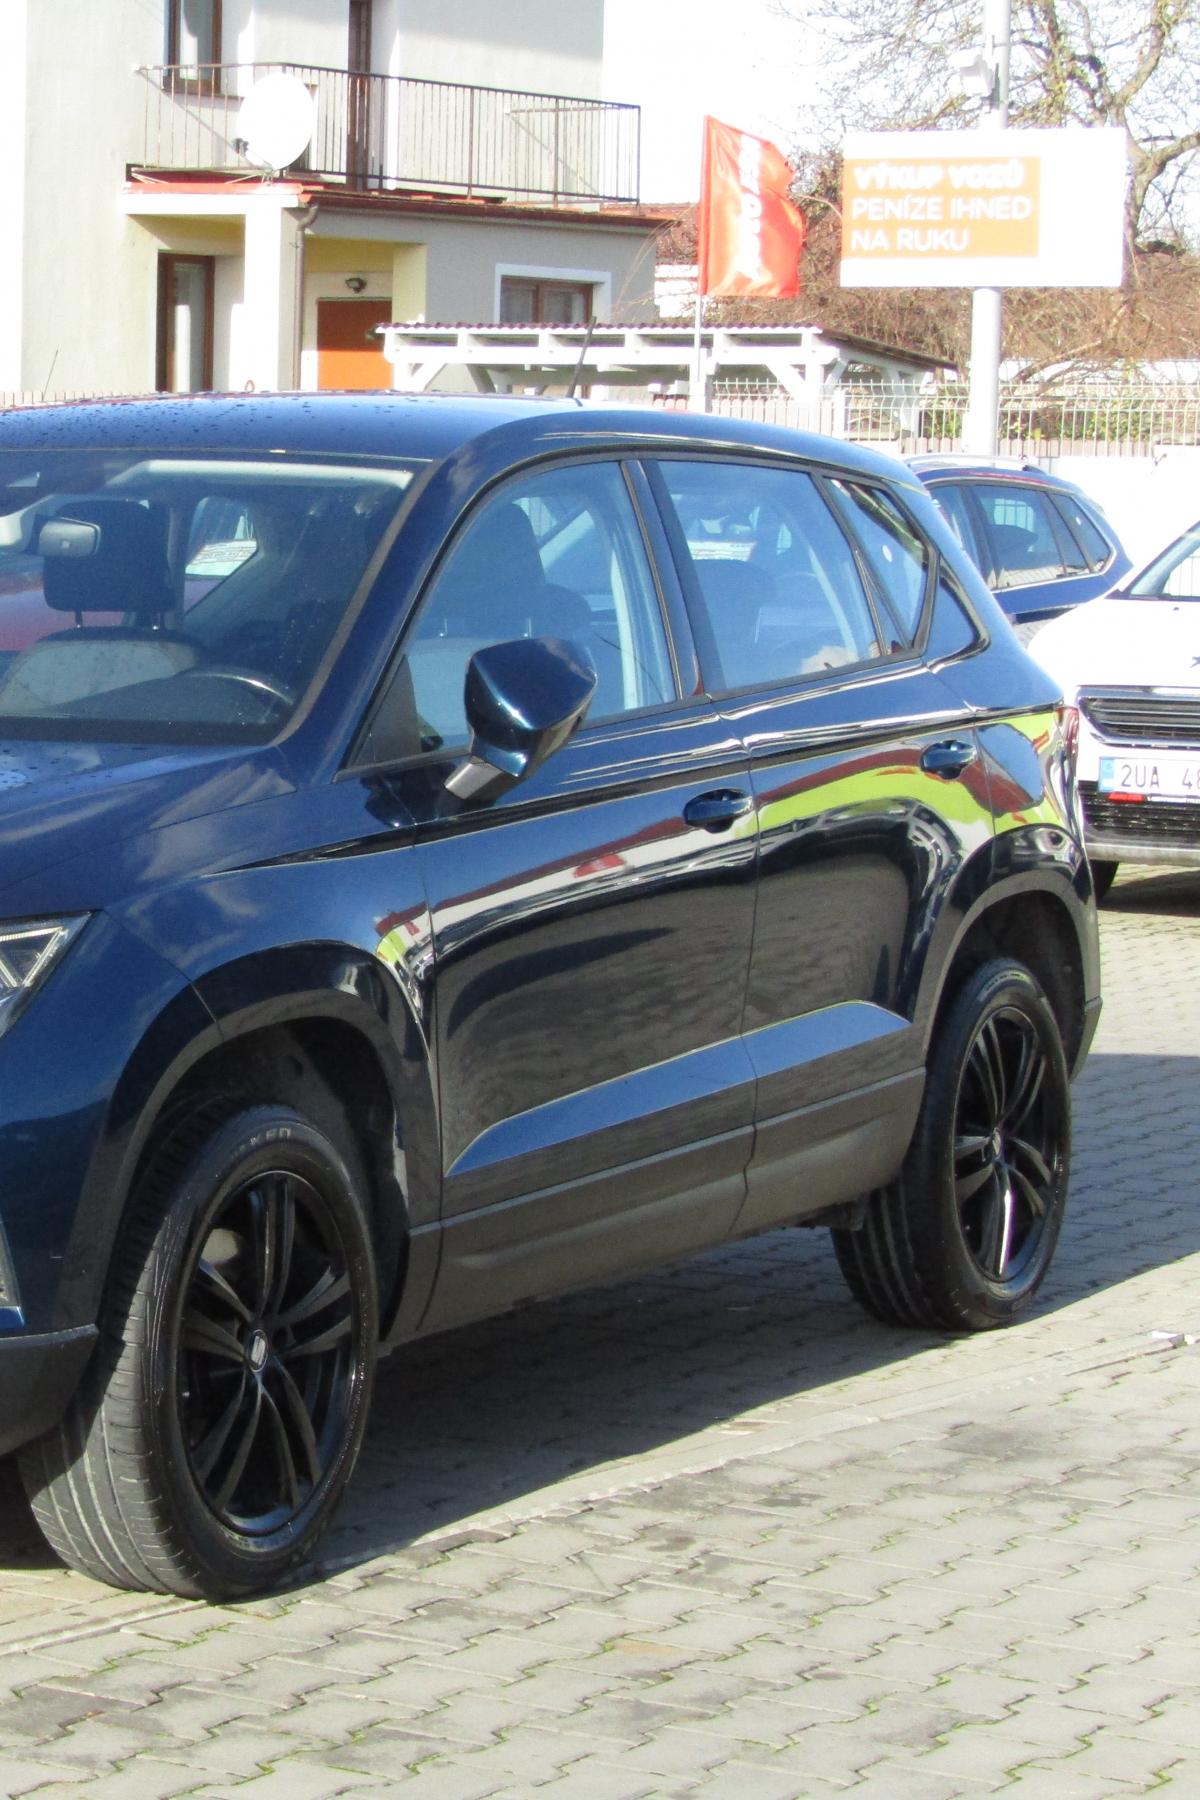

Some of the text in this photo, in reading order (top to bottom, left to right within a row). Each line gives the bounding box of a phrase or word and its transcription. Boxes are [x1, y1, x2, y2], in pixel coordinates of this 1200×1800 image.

[852, 194, 1032, 220] PENÍZE IHNED
[851, 228, 970, 250] NA RUKU
[1121, 764, 1160, 788] 2UA
